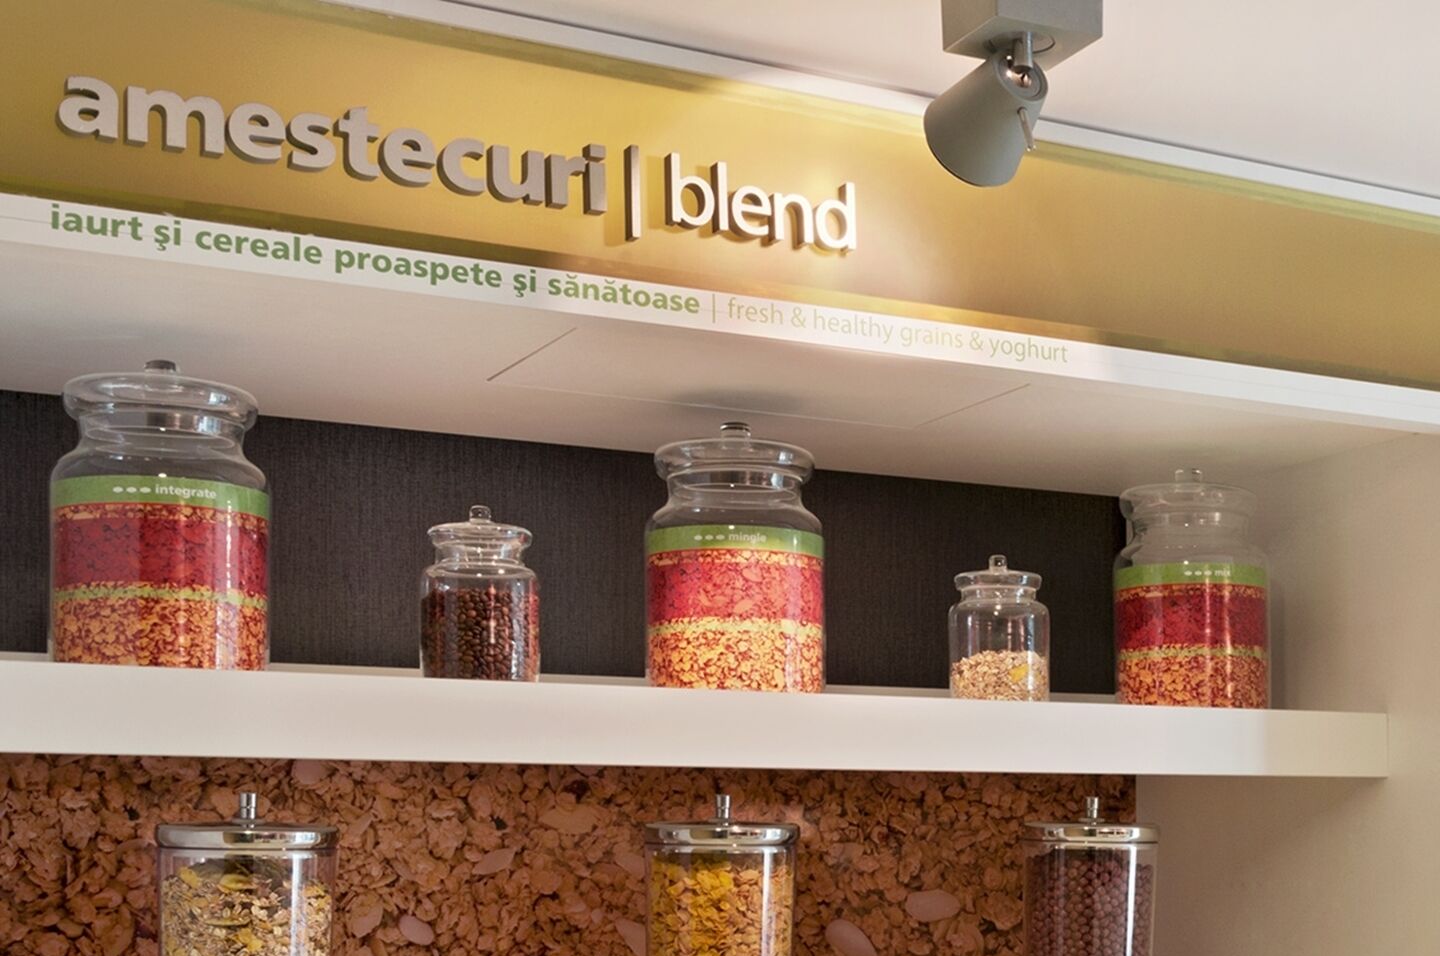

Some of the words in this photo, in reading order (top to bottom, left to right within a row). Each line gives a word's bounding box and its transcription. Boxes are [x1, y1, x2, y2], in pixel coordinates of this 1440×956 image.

[57, 75, 607, 215] amestecuri
[665, 152, 857, 255] blend
[50, 204, 143, 241] iaurt
[195, 229, 322, 265] cereale
[335, 249, 502, 291] proaspete
[548, 274, 700, 313] sănătoase
[728, 297, 784, 326] fresh
[791, 307, 806, 329] &
[813, 313, 894, 344] healthy
[900, 324, 964, 350] grains
[969, 331, 984, 352] &
[988, 334, 1069, 363] yoghurt
[155, 484, 217, 499] integrate
[728, 531, 767, 544] mingle
